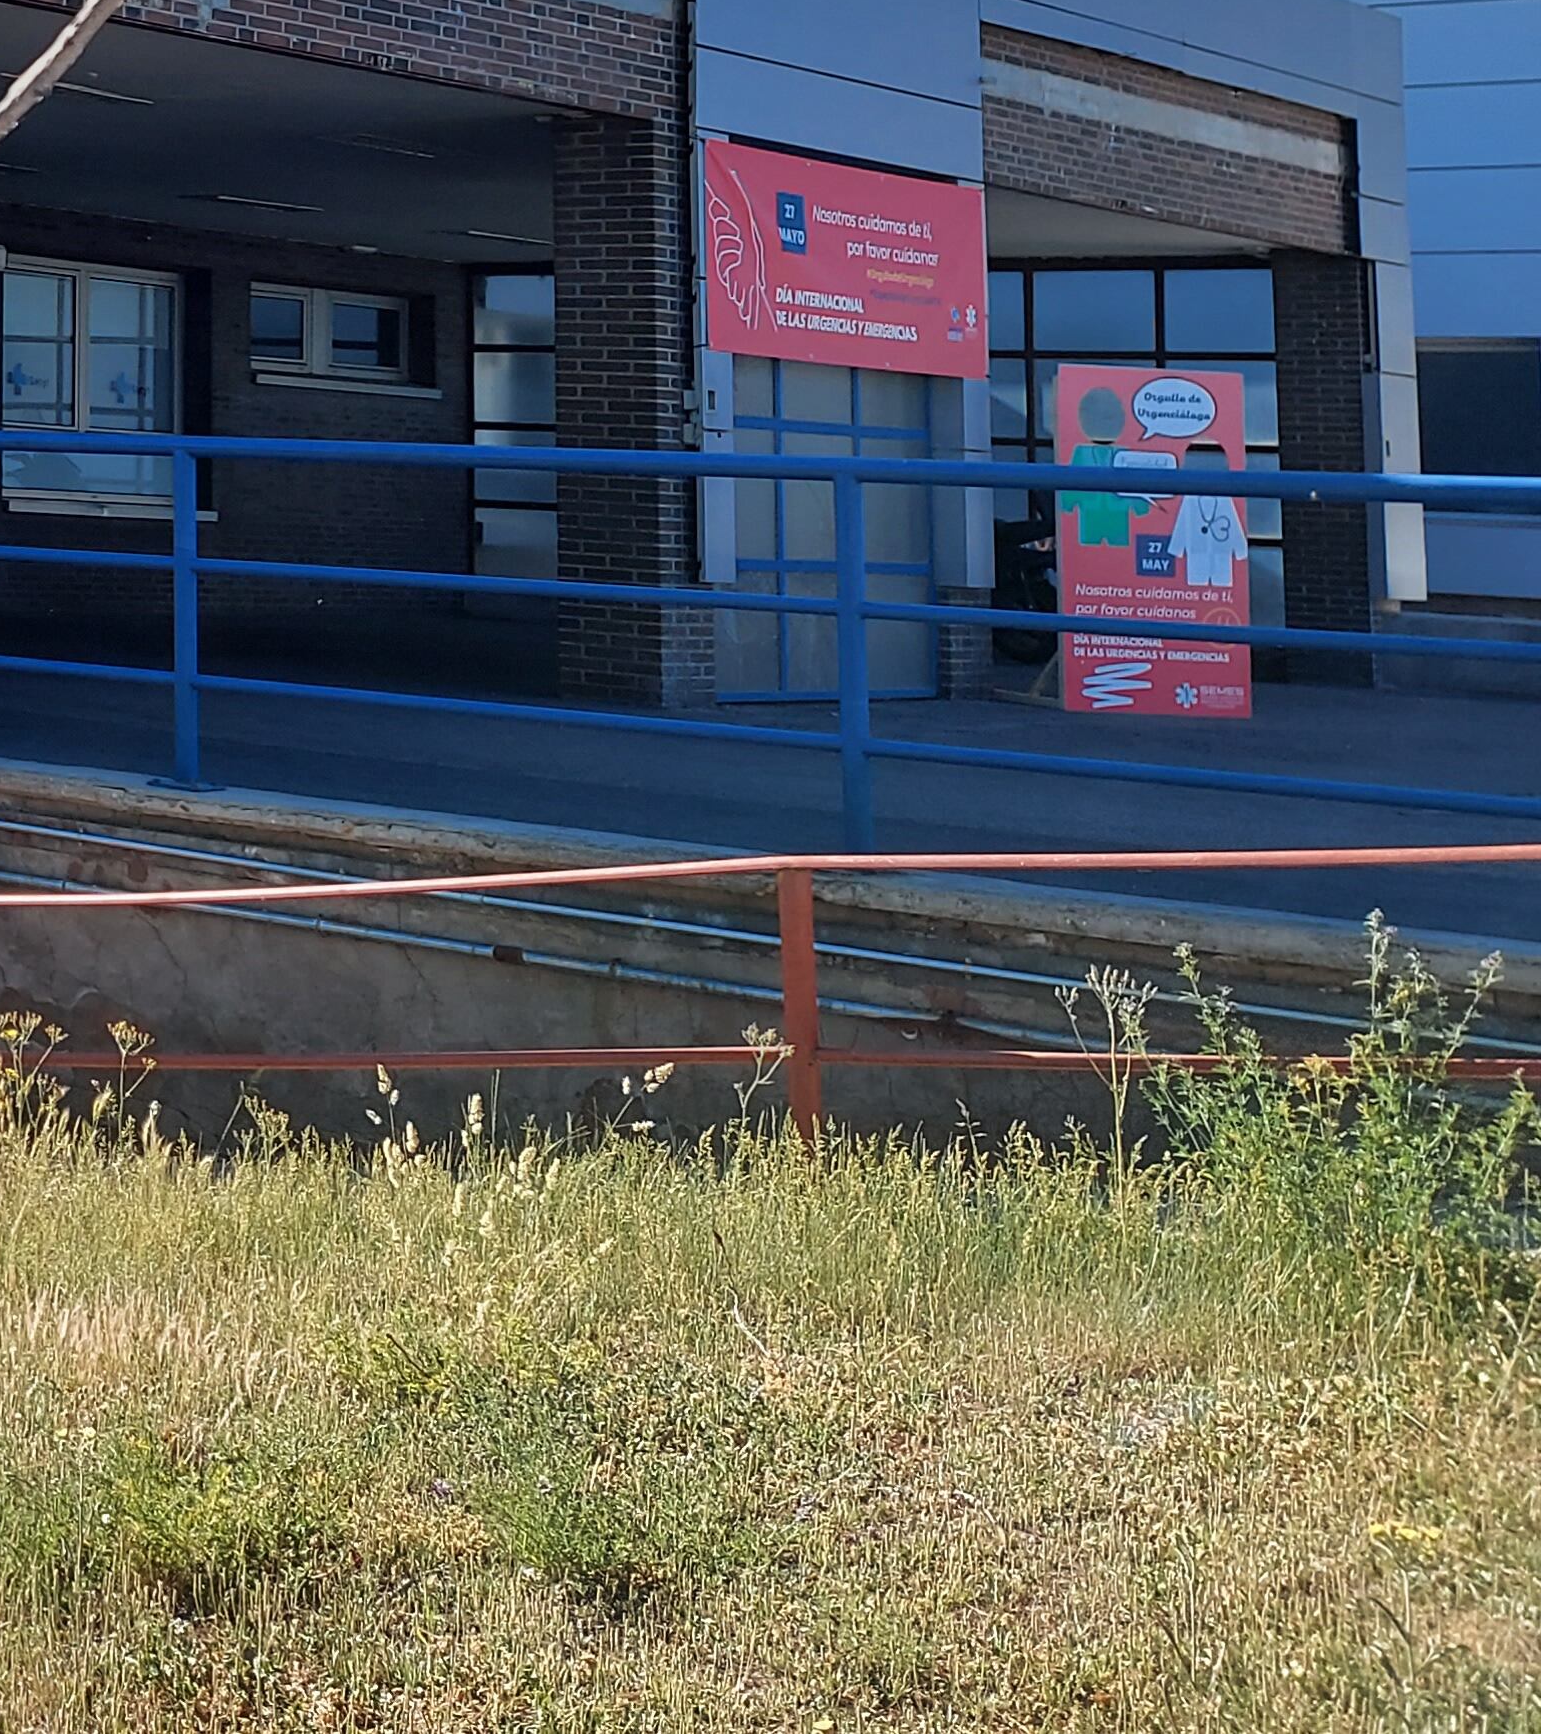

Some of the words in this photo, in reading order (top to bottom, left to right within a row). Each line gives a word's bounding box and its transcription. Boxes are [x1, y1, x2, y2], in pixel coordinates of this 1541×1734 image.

[784, 203, 795, 219] 27
[812, 205, 857, 228] Nosotros
[858, 213, 907, 236] cuidamos
[908, 220, 922, 237] de
[778, 227, 805, 245] MAYO
[846, 242, 864, 259] por
[865, 241, 892, 260] favor
[776, 284, 793, 303] DÍA
[794, 290, 864, 314] INTERNACIONAL
[776, 310, 788, 326] DE
[788, 311, 806, 328] LAS
[807, 314, 856, 335] URGENCIAS
[856, 320, 865, 336] Y
[863, 321, 918, 342] EMERGENCIAS
[1188, 393, 1202, 404] de
[1148, 542, 1163, 554] 27
[1142, 559, 1170, 571] MAY
[1075, 583, 1132, 598] Nosotros
[1135, 586, 1200, 602] cuidamos
[1202, 589, 1218, 602] de
[1075, 604, 1097, 616] por
[1100, 602, 1133, 617] favor
[1091, 634, 1164, 648] INTERNACIONAL
[1073, 647, 1086, 657] DE
[1087, 647, 1104, 658] LAS
[1106, 648, 1158, 661] URGENCIAS
[1159, 650, 1167, 660] Y
[1167, 651, 1230, 663] EMERGENCIAS
